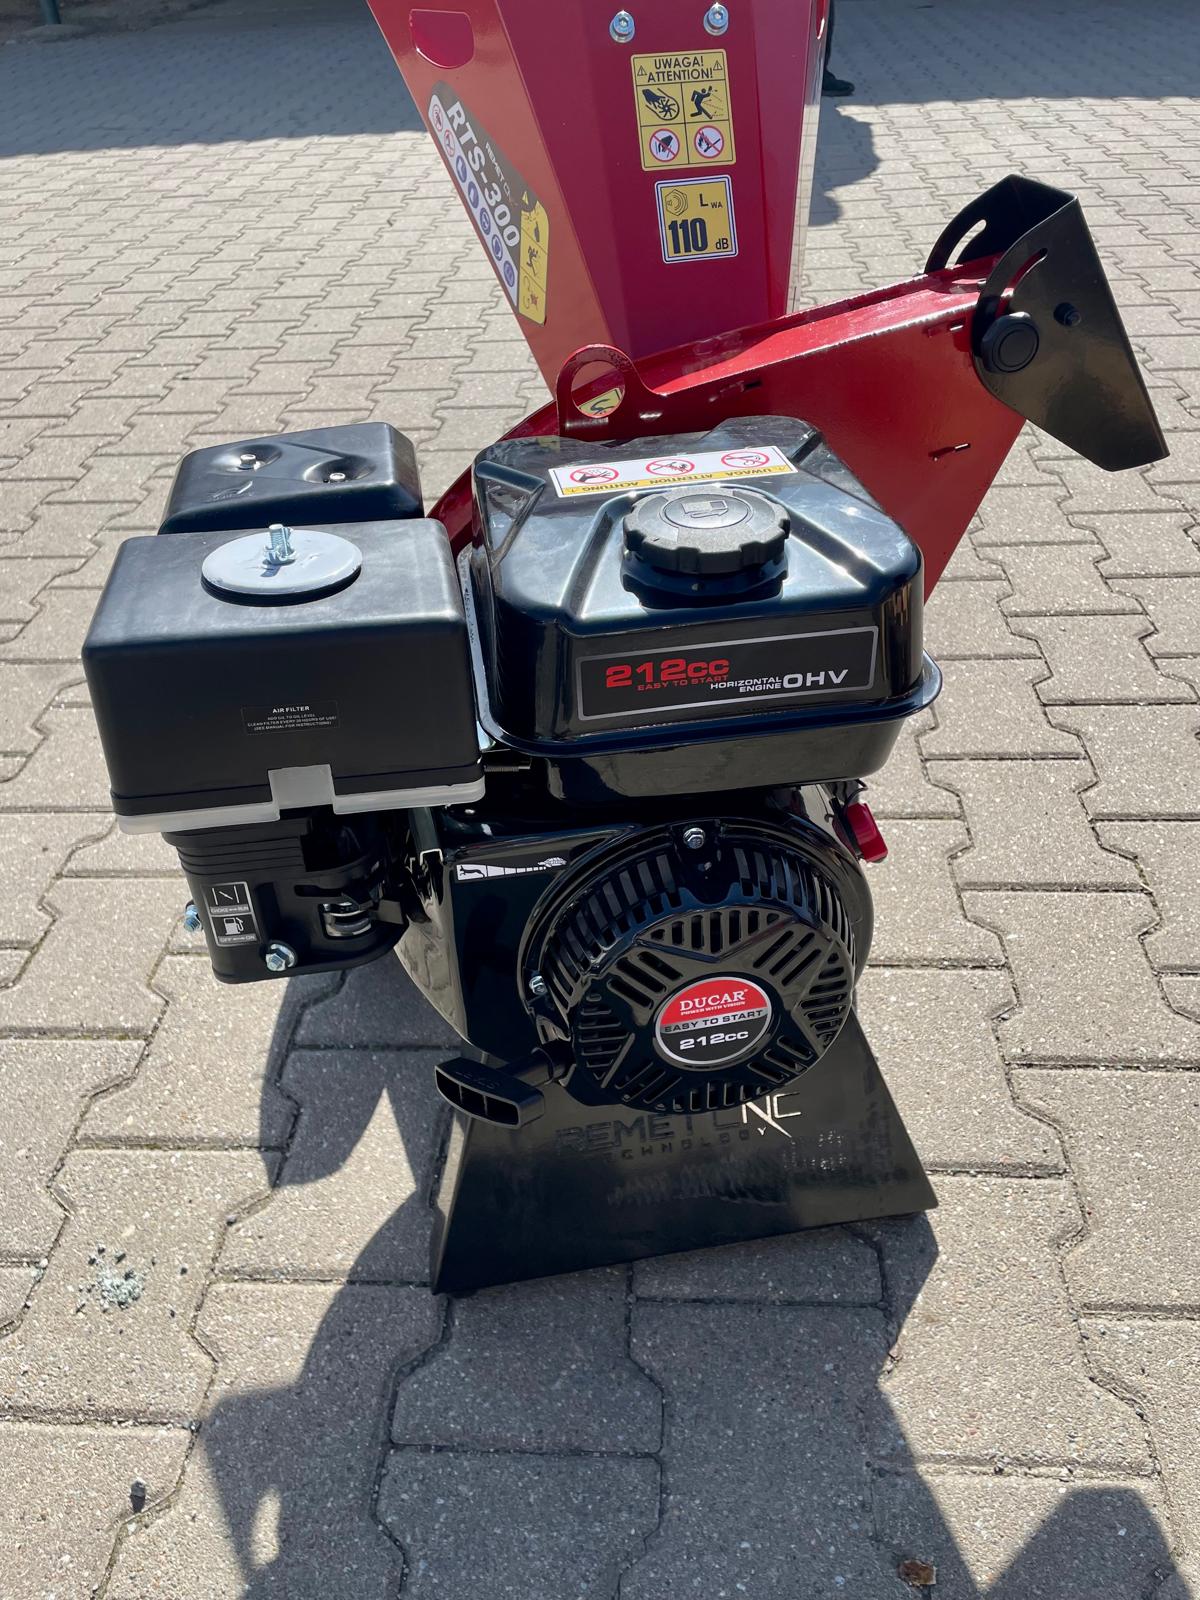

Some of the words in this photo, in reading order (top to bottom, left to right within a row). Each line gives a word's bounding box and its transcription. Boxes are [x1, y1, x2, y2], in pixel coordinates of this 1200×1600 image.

[654, 55, 704, 70] UWAGA!
[647, 67, 713, 83] ATTENTION!
[447, 101, 520, 247] RTS-300
[699, 193, 709, 207] L
[710, 201, 723, 209] WA
[668, 217, 709, 254] 110
[715, 237, 729, 250] dB
[650, 473, 713, 484] ATTENTION
[725, 468, 772, 477] UWAGA
[582, 481, 639, 491] ACHTUNG
[605, 658, 730, 689] 212cc
[710, 676, 783, 690] HORIZONTAL
[782, 669, 849, 689] OHV
[637, 681, 669, 691] EASY
[673, 679, 688, 687] TO
[691, 674, 728, 685] START
[739, 682, 782, 693] ENGINE
[285, 705, 310, 713] FILTER
[680, 990, 746, 1011] DUCAR
[664, 1021, 699, 1032] EASY
[702, 1018, 719, 1026] TO
[722, 1010, 765, 1023] START
[680, 1031, 749, 1050] 212cc
